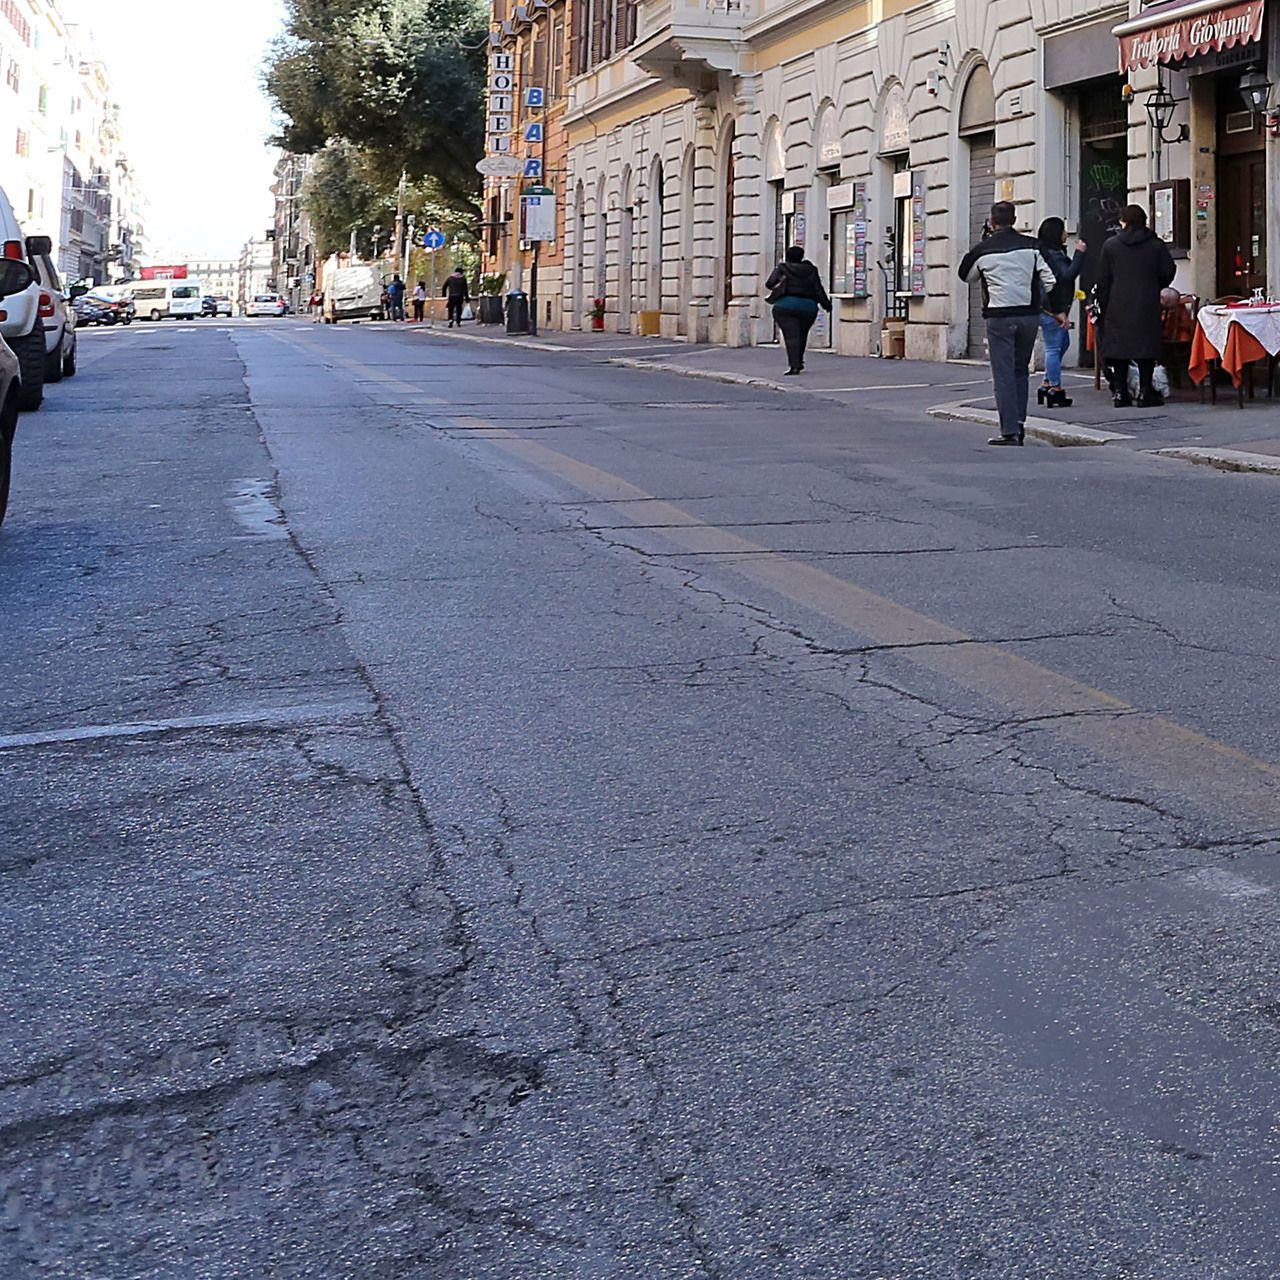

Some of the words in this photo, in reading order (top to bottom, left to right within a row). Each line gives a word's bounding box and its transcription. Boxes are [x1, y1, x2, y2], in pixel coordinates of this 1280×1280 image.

[1131, 29, 1181, 61] Trattoria
[1190, 6, 1251, 46] Giovanni
[494, 55, 511, 152] HOTEL
[525, 89, 542, 176] BAR
